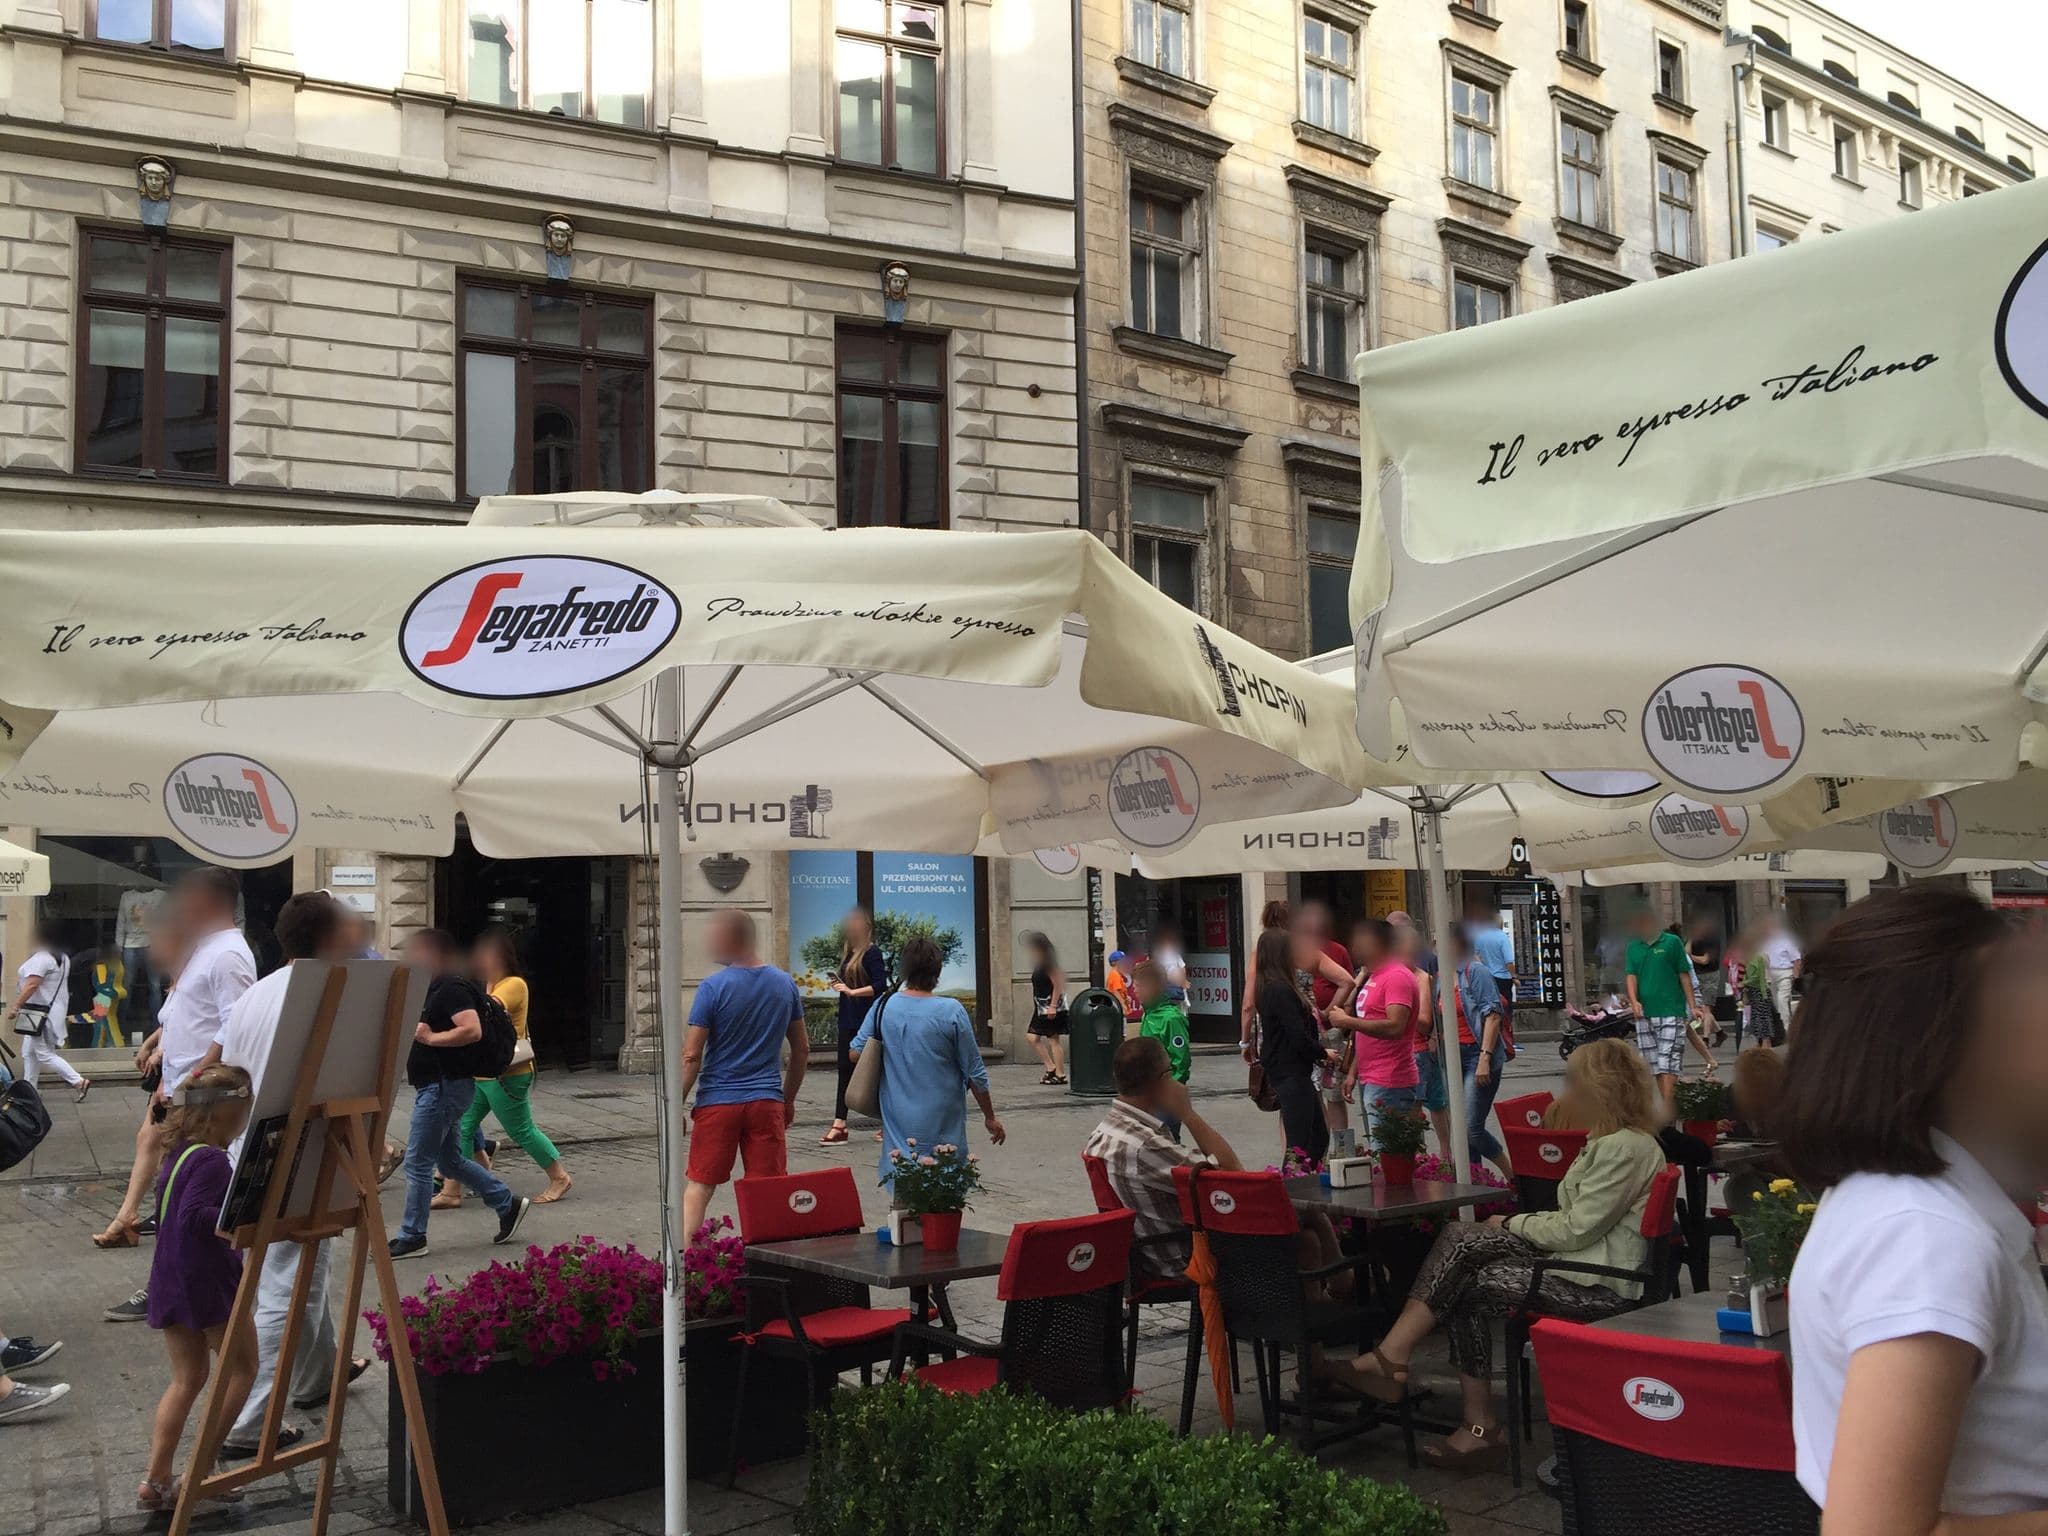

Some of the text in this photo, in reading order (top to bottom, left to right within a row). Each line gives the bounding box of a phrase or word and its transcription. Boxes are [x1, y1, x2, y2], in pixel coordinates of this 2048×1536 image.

[1476, 345, 1939, 485] Il vero espresso italiano
[420, 572, 660, 667] Segafredo
[706, 597, 1037, 640] Prawdziwe włoskie espresso
[42, 617, 368, 660] Il vero espresso italiano
[527, 636, 610, 653] ZANETTI
[1227, 661, 1307, 728] CHOPIN
[882, 874, 965, 882] PRZENIESIONY NA
[907, 863, 939, 871] SALON
[880, 885, 896, 893] UL.
[1198, 988, 1229, 1004] 19,90
